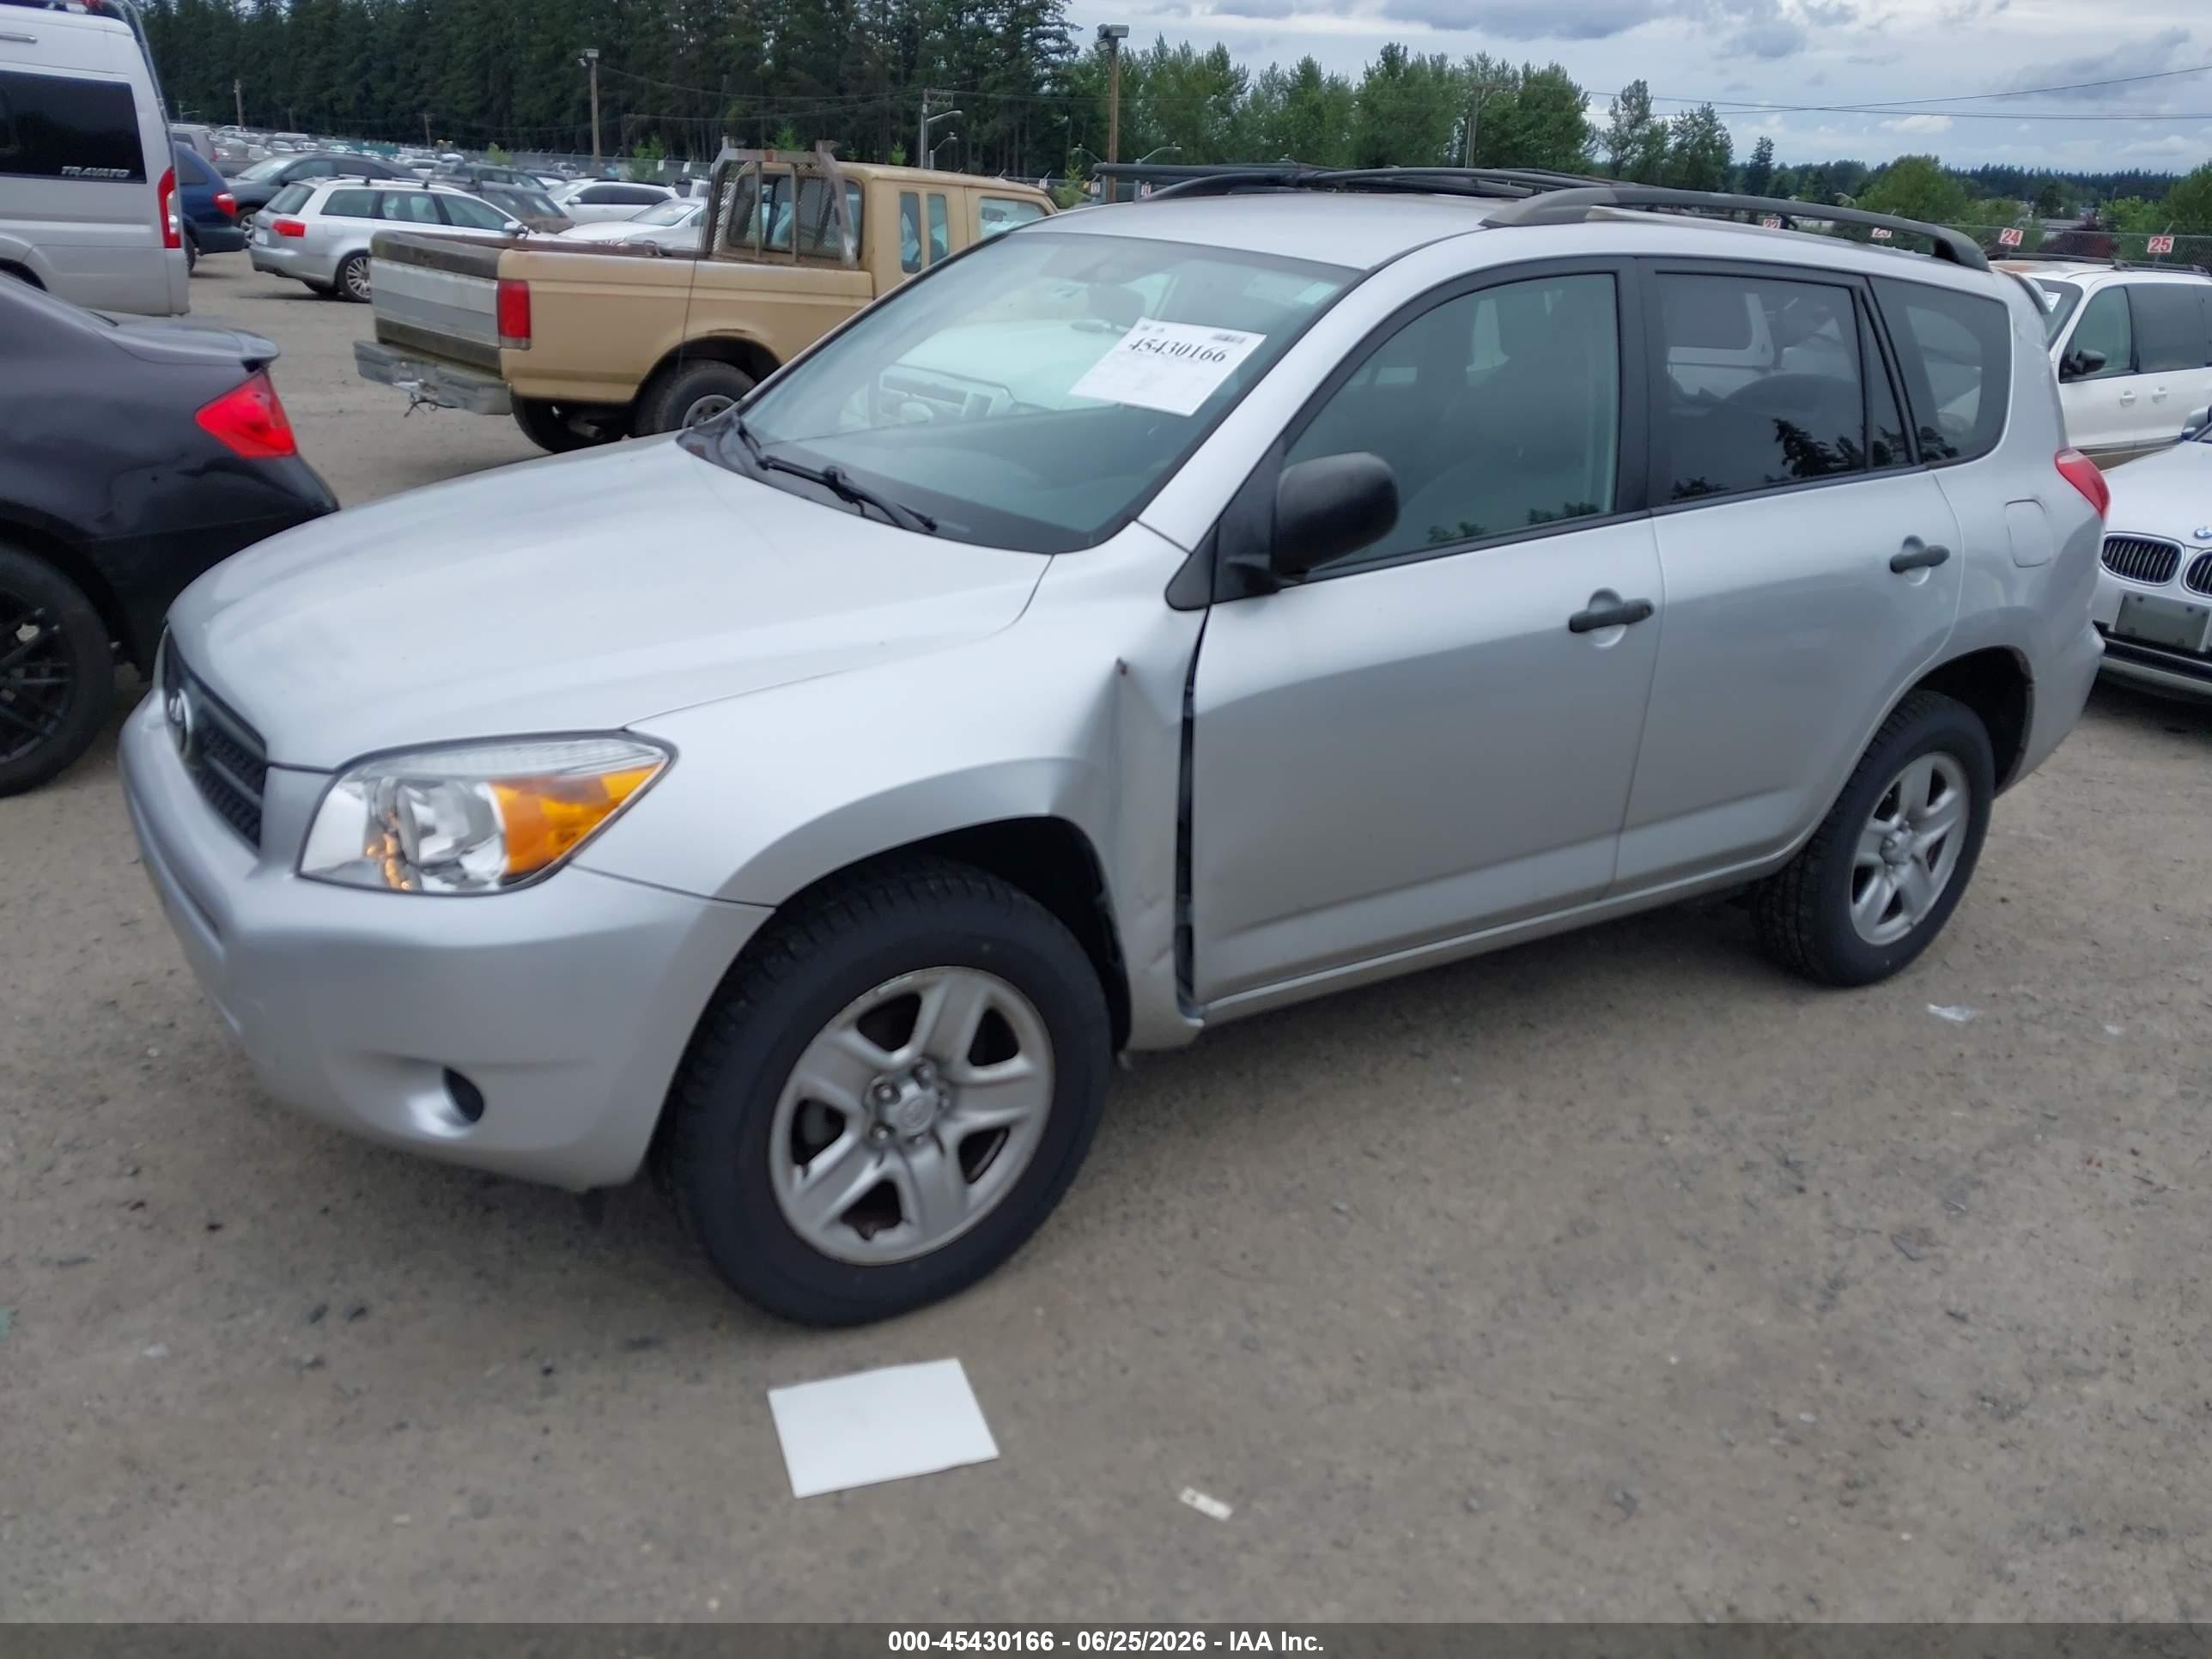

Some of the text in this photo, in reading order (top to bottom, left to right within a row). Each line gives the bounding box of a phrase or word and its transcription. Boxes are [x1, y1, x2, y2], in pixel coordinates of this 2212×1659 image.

[61, 166, 131, 179] TRAVATO
[2002, 229, 2021, 245] 24
[2149, 237, 2171, 252] 25
[1128, 337, 1231, 362] 45430166
